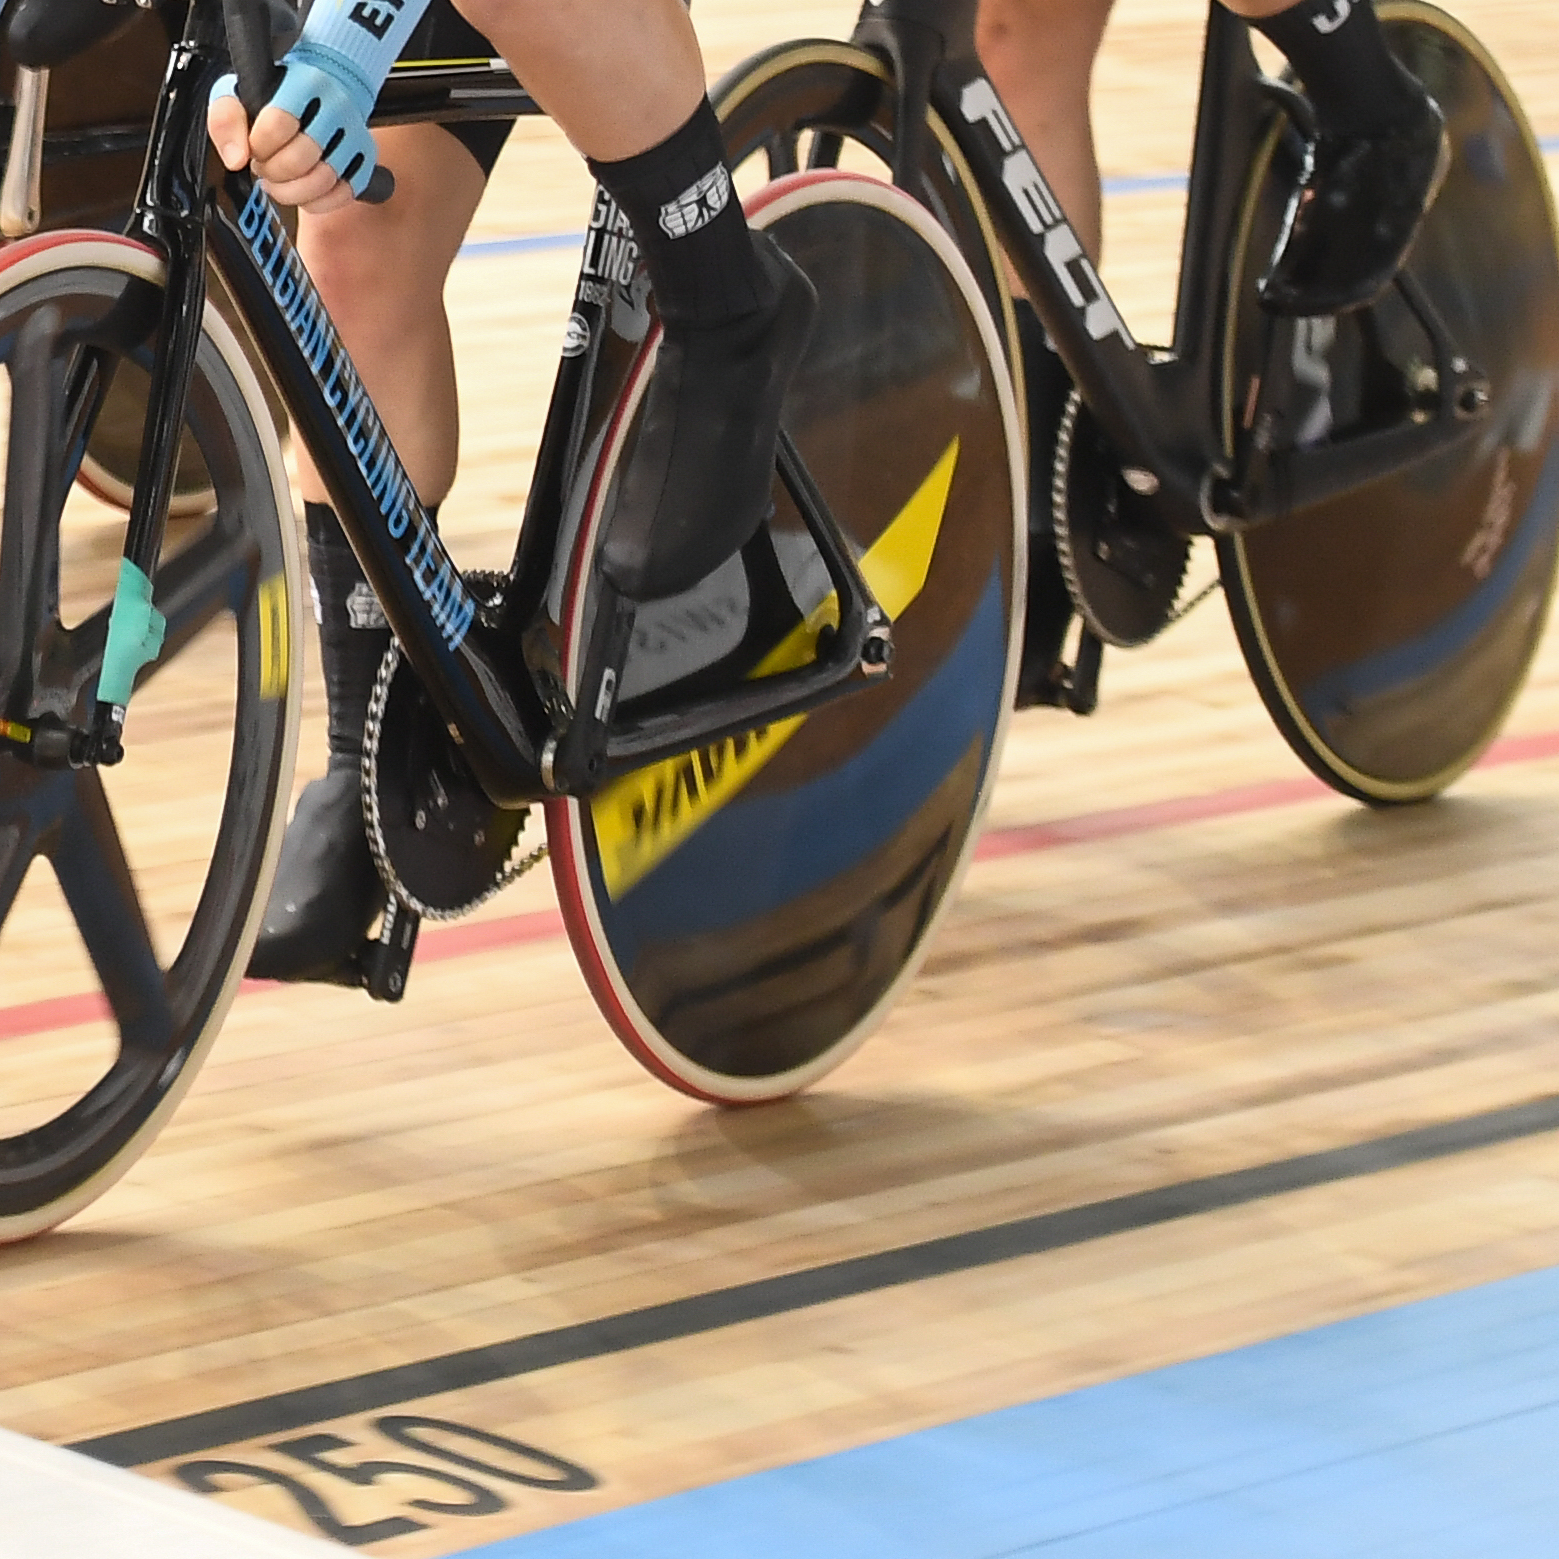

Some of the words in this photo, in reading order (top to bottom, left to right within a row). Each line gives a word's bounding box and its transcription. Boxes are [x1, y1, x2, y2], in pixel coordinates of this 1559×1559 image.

[960, 76, 1138, 352] FELT
[237, 178, 334, 377] BELGIAN
[323, 354, 414, 540] CYCLING
[404, 530, 475, 652] TEAM
[172, 1413, 603, 1547] 250
